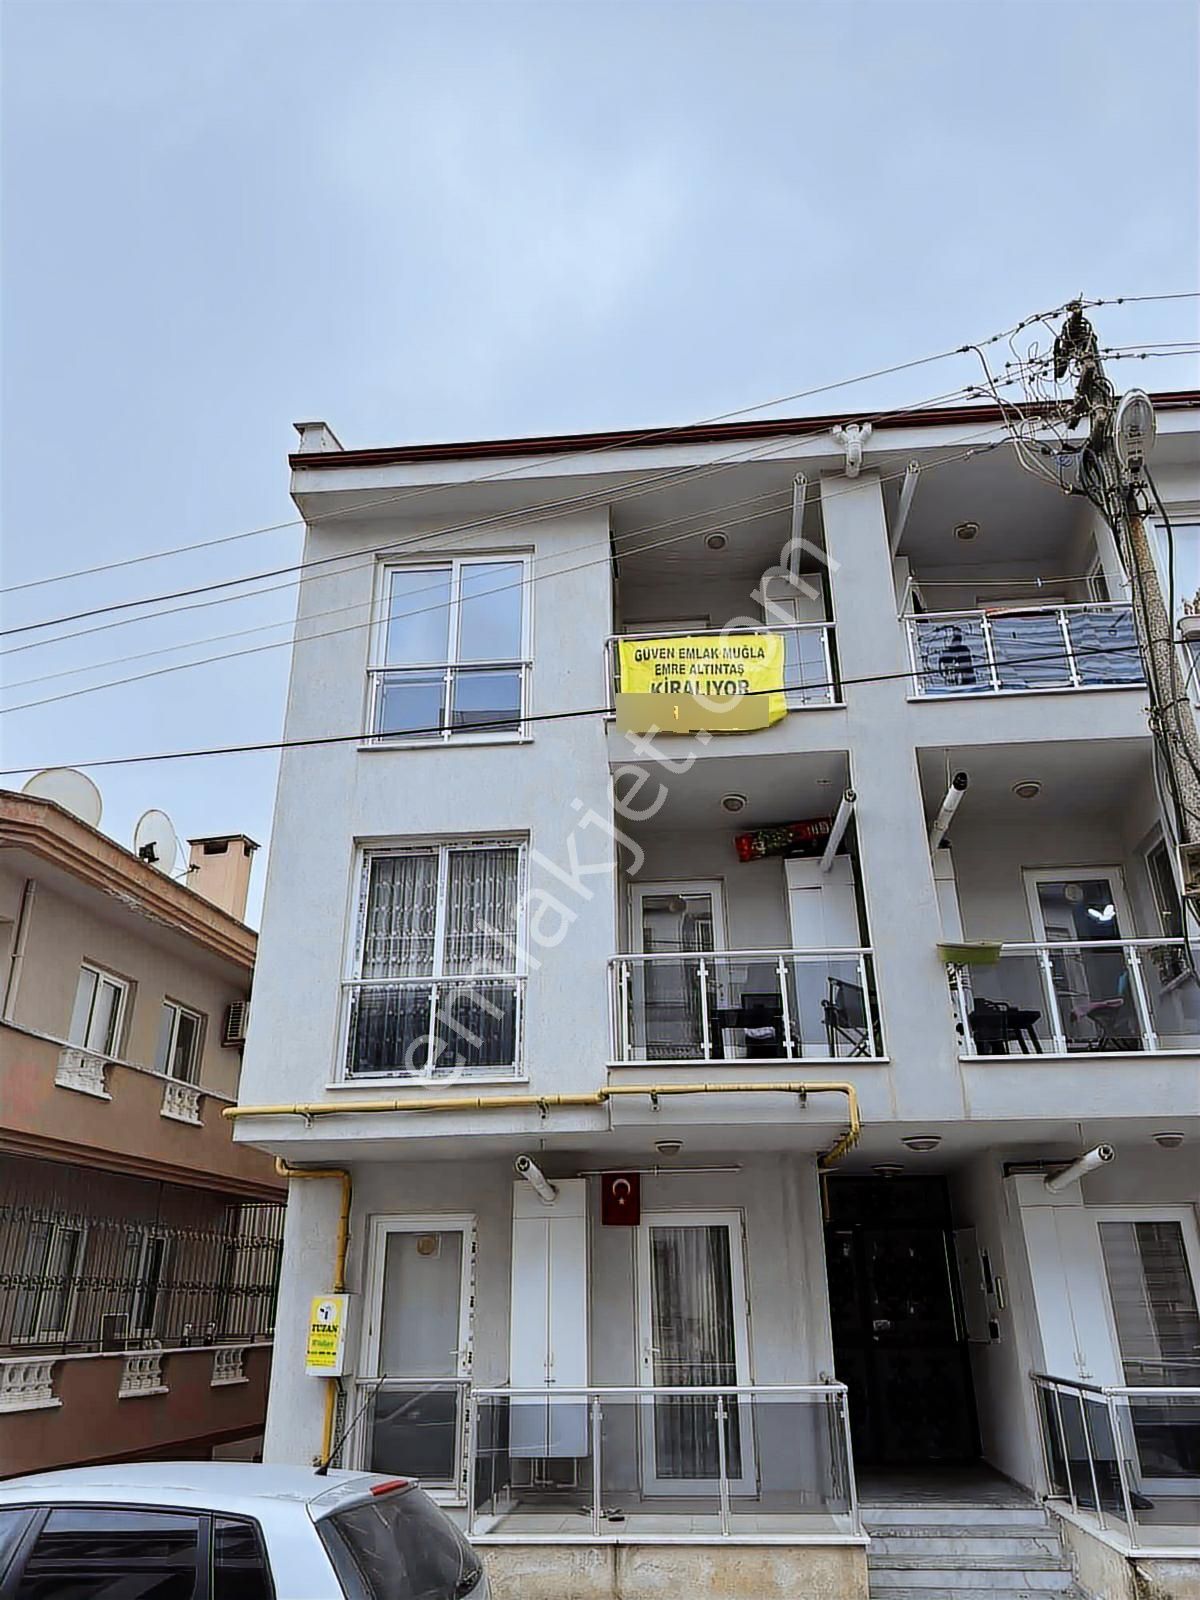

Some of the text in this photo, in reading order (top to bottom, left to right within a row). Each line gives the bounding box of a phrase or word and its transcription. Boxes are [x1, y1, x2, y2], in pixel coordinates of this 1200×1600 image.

[635, 645, 765, 662] GÜVEN EMLAK MUĞLA
[655, 663, 744, 677] EMRE ALTINTAŞ
[651, 677, 750, 695] KİRALIYOR
